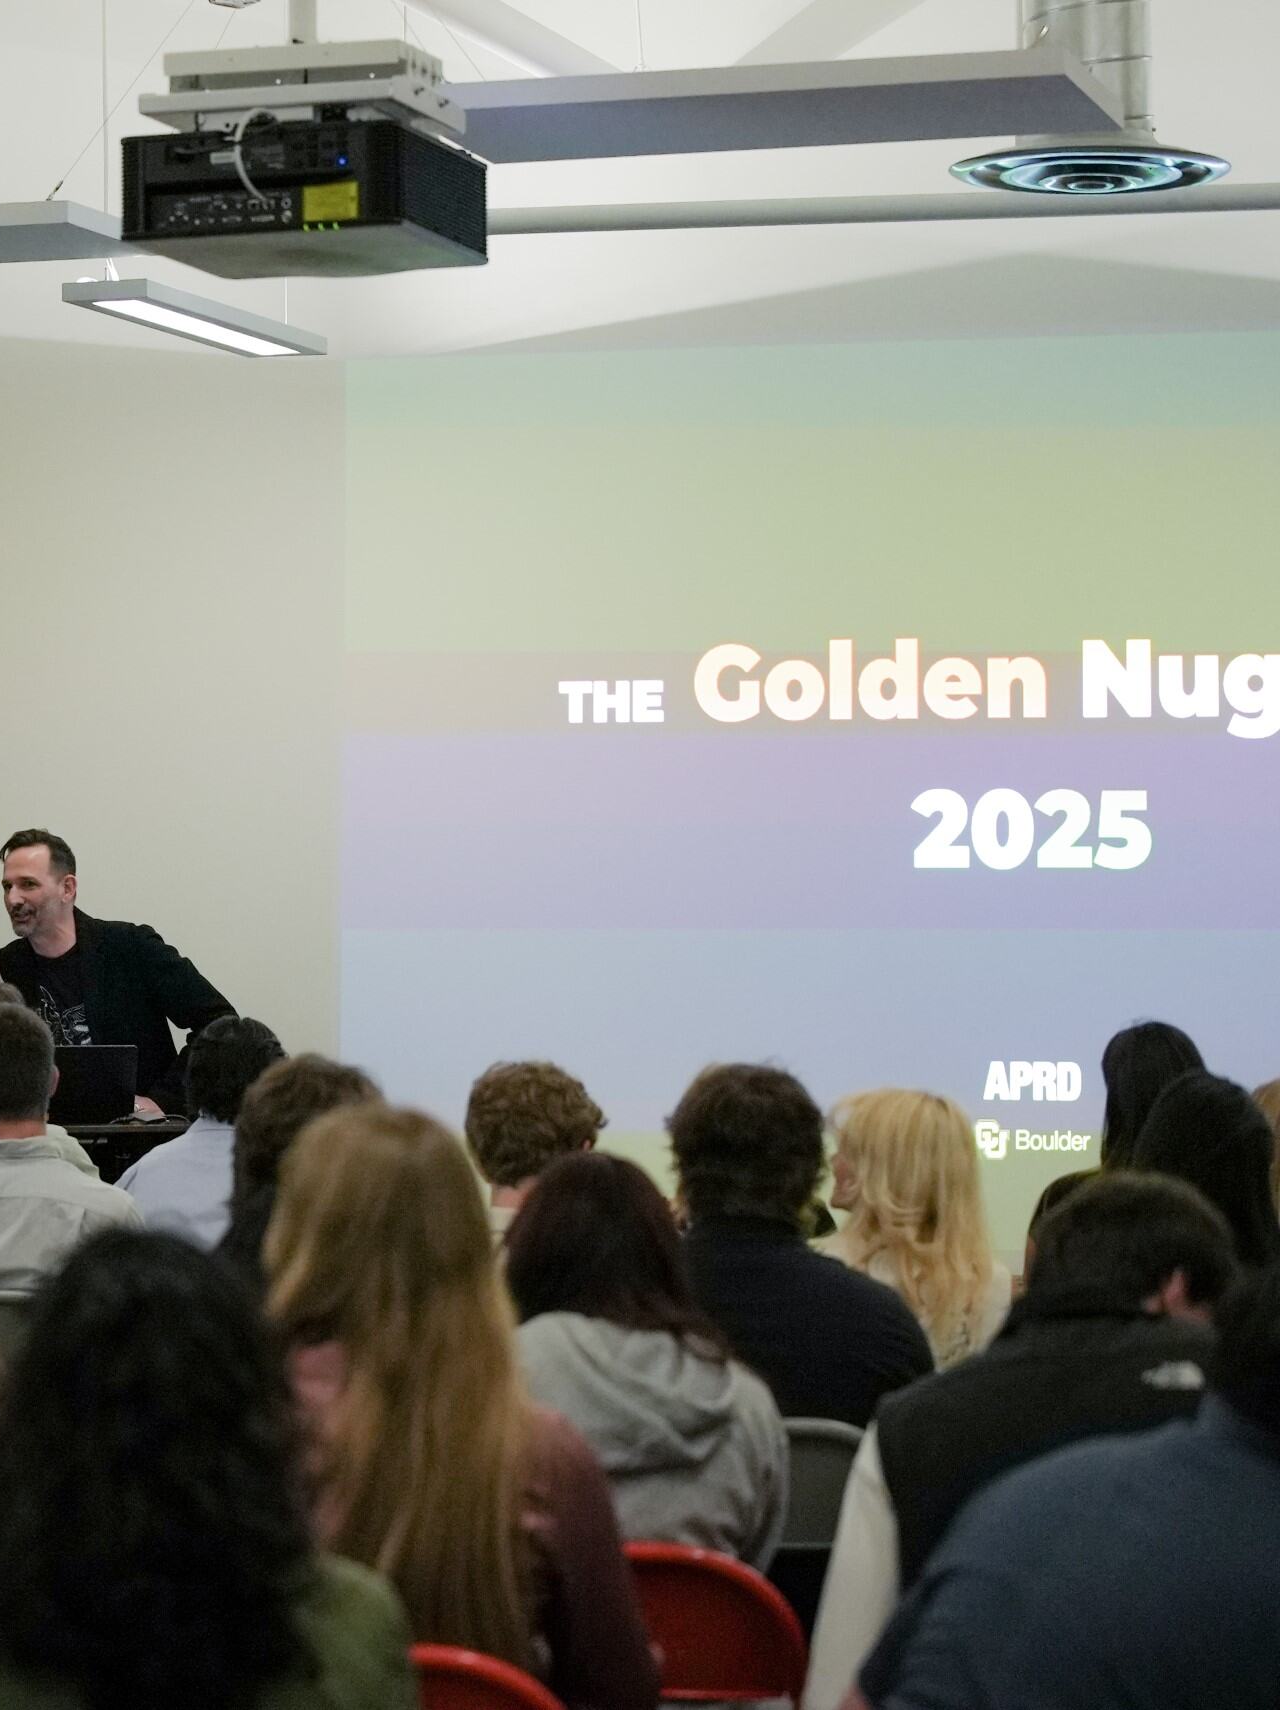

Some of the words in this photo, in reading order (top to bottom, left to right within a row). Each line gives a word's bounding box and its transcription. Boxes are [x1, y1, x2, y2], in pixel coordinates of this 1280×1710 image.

[558, 680, 665, 723] THE
[694, 638, 1047, 722] Golden
[1082, 638, 1280, 740] Nug
[910, 788, 1152, 870] 2025
[983, 1060, 1082, 1101] APRD
[1015, 1129, 1091, 1151] Boulder
